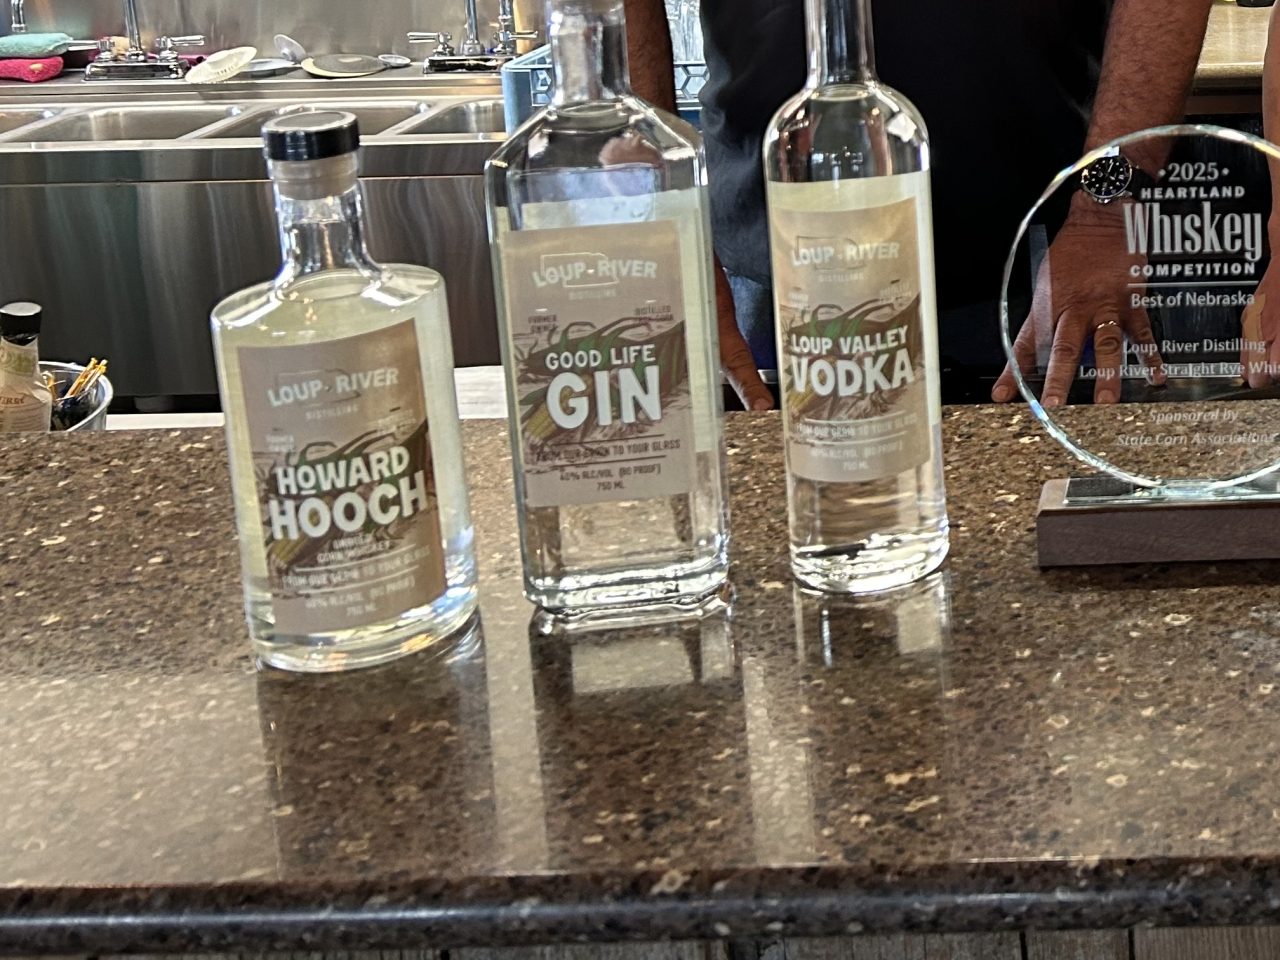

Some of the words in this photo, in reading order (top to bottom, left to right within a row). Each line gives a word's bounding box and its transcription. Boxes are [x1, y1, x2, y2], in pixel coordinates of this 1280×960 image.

[1168, 162, 1220, 182] 2025
[1140, 186, 1246, 200] HEARTLAND
[1122, 201, 1262, 260] Whiskey
[791, 247, 834, 266] LOUP
[846, 242, 900, 260] RIVER
[532, 262, 586, 288] LOUP
[600, 259, 658, 280] RIVER
[1130, 262, 1256, 277] COMPETITION
[1131, 293, 1164, 308] Best
[1168, 292, 1182, 307] of
[1186, 290, 1256, 307] Nebraska
[792, 334, 832, 355] LOUP
[840, 325, 908, 355] VALLEY
[1124, 340, 1158, 356] Loup
[1162, 338, 1200, 352] River
[1203, 338, 1267, 355] Distilling
[546, 348, 601, 370] GOOD
[611, 344, 656, 366] LIFE
[790, 348, 915, 397] VODKA
[1080, 365, 1115, 380] Loup
[1120, 364, 1157, 378] River
[1160, 360, 1216, 378] Straight
[1219, 362, 1246, 378] Rye
[267, 379, 322, 406] LOUP
[336, 367, 400, 394] RIVER
[547, 364, 662, 429] GIN
[1150, 407, 1218, 424] Sponsored
[1223, 408, 1239, 424] by
[1117, 434, 1152, 446] State
[1156, 433, 1188, 446] Corn
[276, 446, 410, 495] HOWARD
[268, 470, 429, 540] HOOCH
